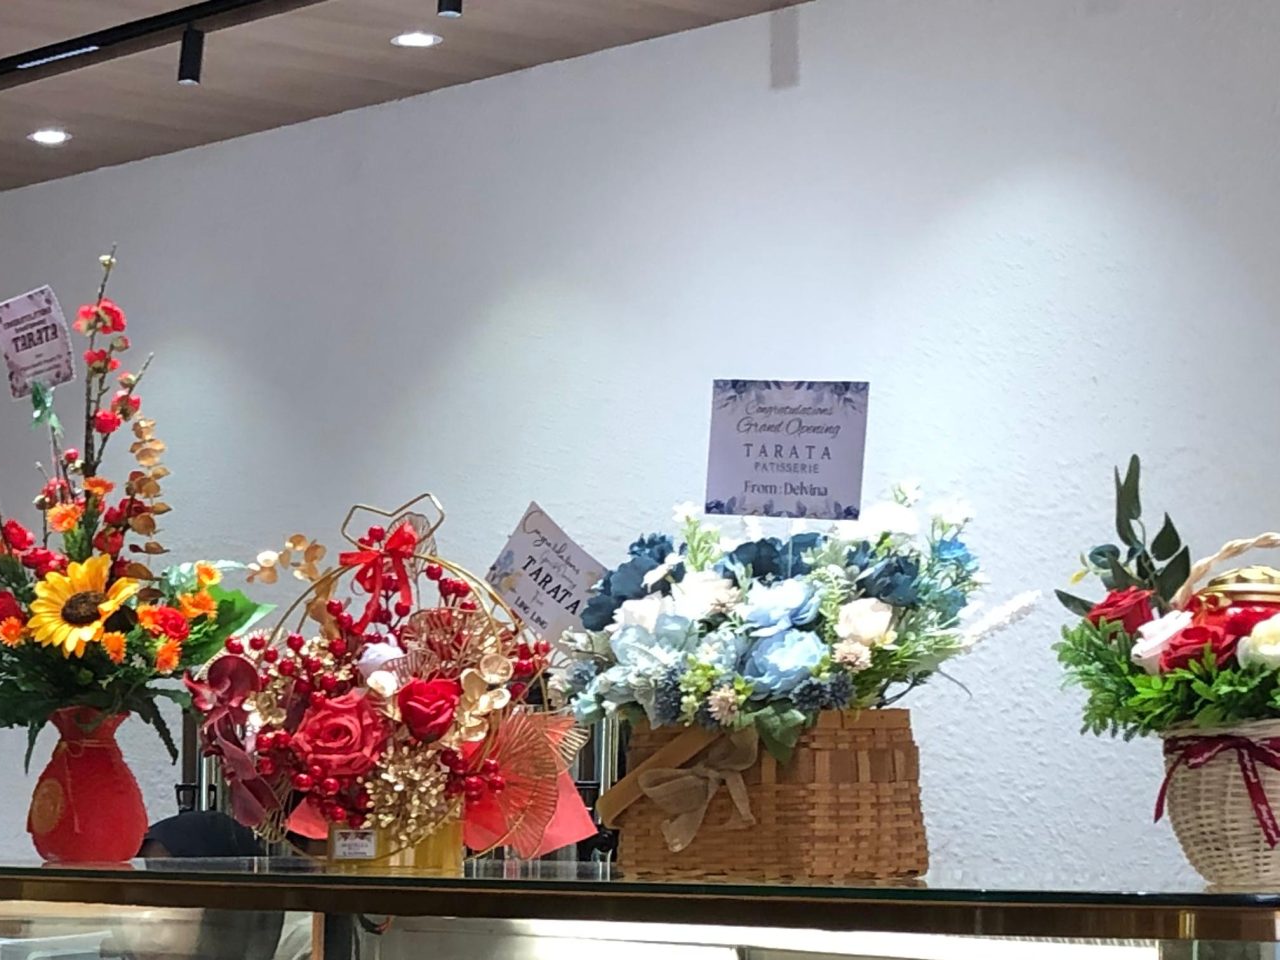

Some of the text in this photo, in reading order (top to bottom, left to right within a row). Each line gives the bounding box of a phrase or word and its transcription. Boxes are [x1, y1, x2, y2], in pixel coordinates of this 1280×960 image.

[736, 416, 841, 439] Grand Opening
[743, 443, 832, 460] TARATA
[754, 462, 820, 474] PATISSERIE
[784, 481, 828, 496] Delvina
[521, 554, 582, 616] TARATA
